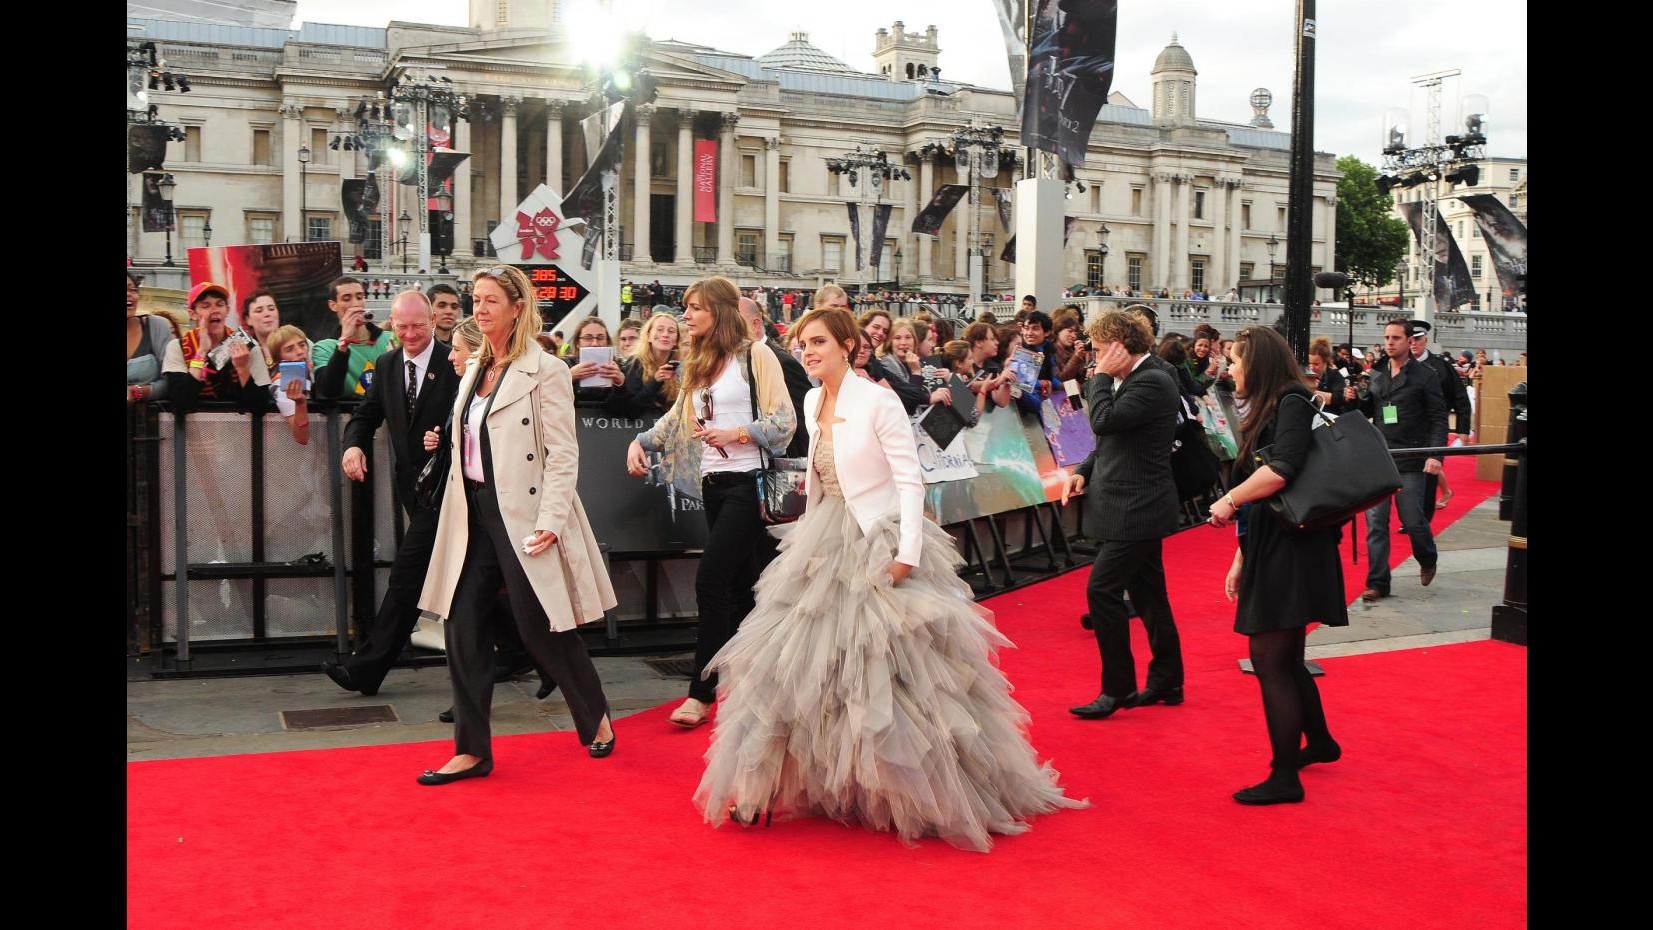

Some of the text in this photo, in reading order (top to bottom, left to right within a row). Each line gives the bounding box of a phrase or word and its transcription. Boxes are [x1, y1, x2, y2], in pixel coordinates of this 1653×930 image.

[1071, 121, 1080, 133] 2
[704, 153, 714, 193] GALLERY
[531, 269, 556, 281] 385
[559, 286, 577, 298] 30
[581, 417, 644, 429] WORLD
